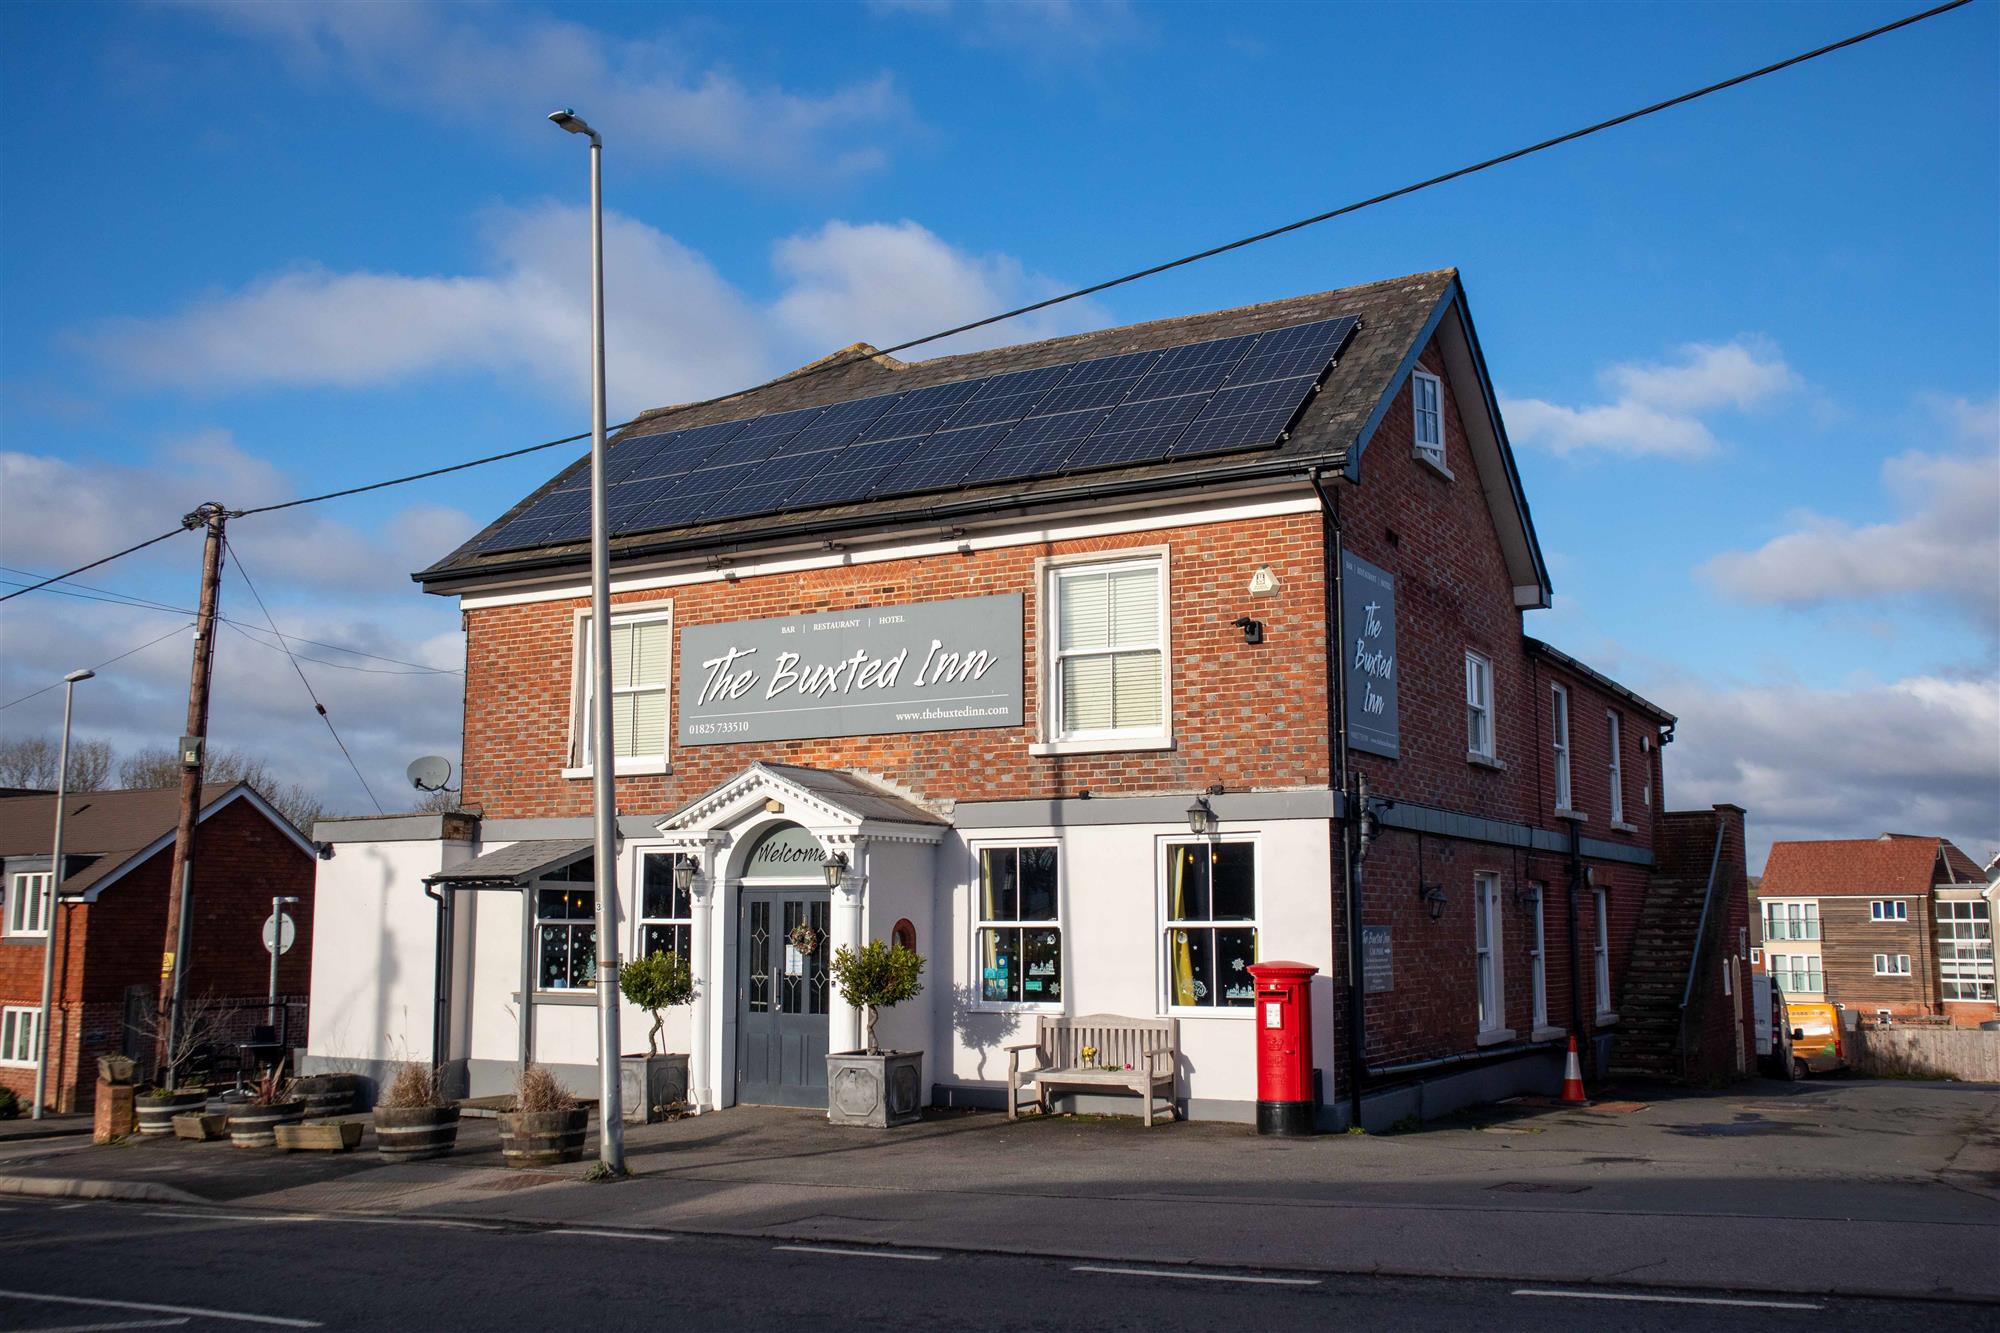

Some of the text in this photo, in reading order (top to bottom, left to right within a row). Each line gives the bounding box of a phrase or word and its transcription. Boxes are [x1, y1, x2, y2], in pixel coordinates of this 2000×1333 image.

[781, 615, 905, 634] BAR RESTAURANT HOTEL
[1364, 601, 1382, 639] The
[1355, 638, 1393, 680] Buxted
[697, 639, 999, 706] The Buxted Inn
[1363, 681, 1384, 716] Inn
[895, 705, 1009, 722] www.thebuxtedinn.com
[689, 721, 749, 735] 01825 733510
[758, 842, 828, 863] Welcome
[596, 903, 602, 911] 3
